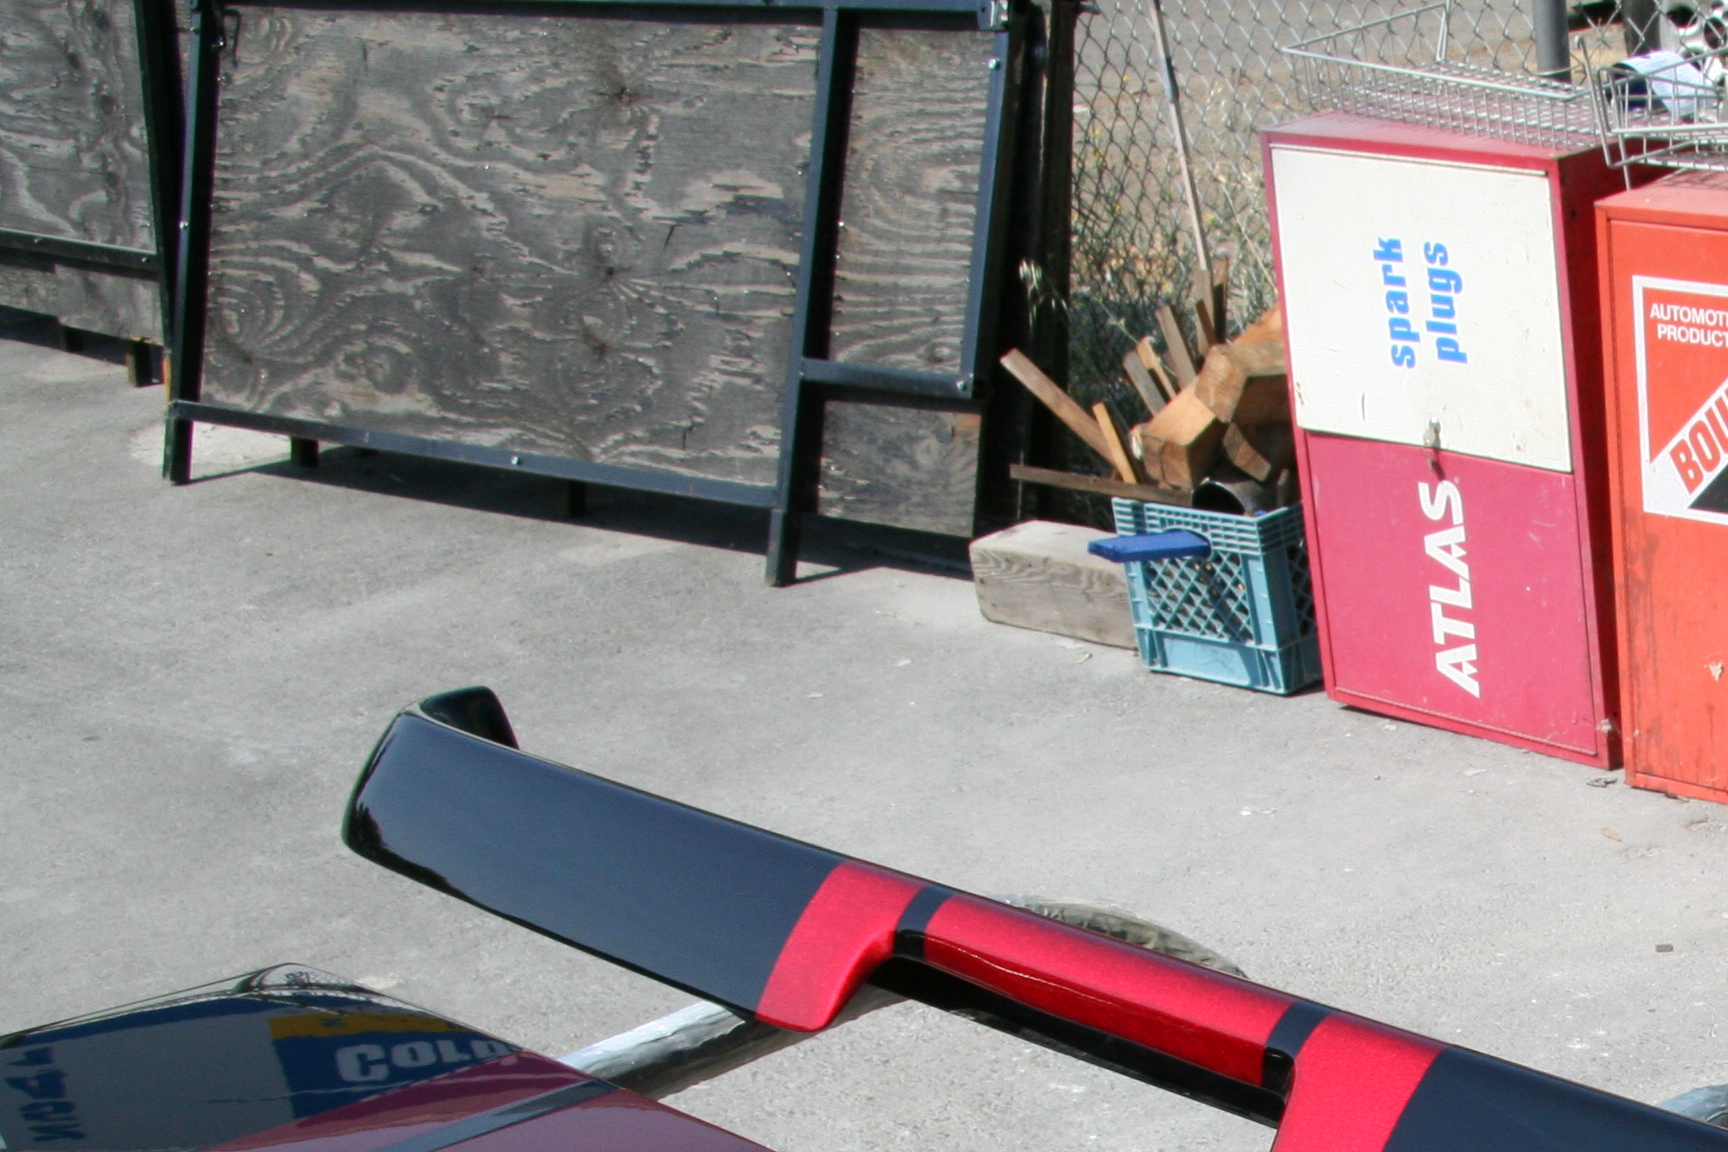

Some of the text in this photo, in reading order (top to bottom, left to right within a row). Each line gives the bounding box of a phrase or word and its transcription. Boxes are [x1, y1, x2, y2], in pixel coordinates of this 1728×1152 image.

[1373, 236, 1420, 369] spark
[1423, 241, 1468, 364] plugs
[1417, 479, 1481, 699] ATLAS
